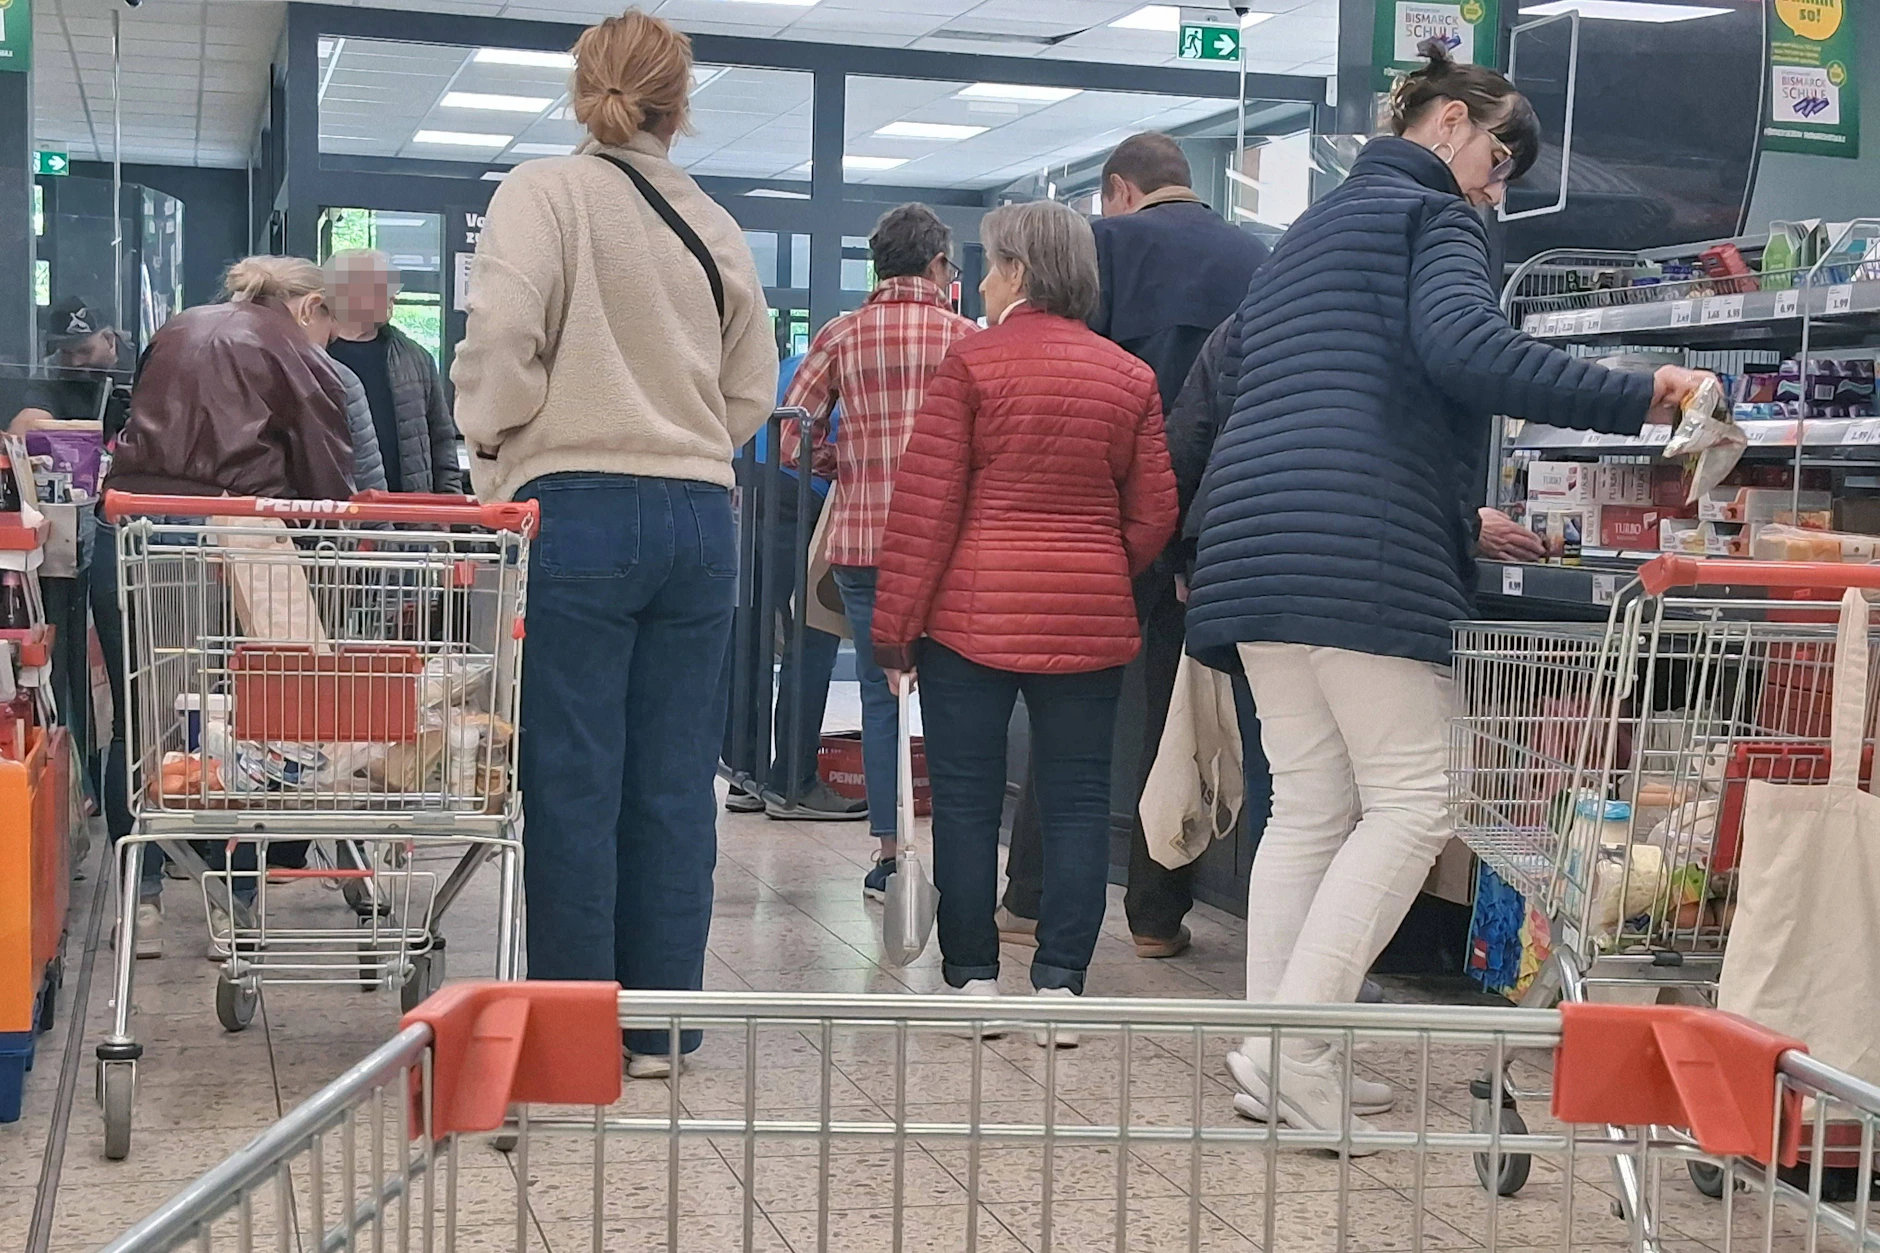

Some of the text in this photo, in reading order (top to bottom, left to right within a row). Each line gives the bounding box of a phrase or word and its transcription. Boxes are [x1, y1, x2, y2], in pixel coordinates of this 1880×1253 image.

[1405, 12, 1459, 25] BISMARCK
[1799, 8, 1821, 23] so!
[1781, 76, 1826, 88] BISMARCK
